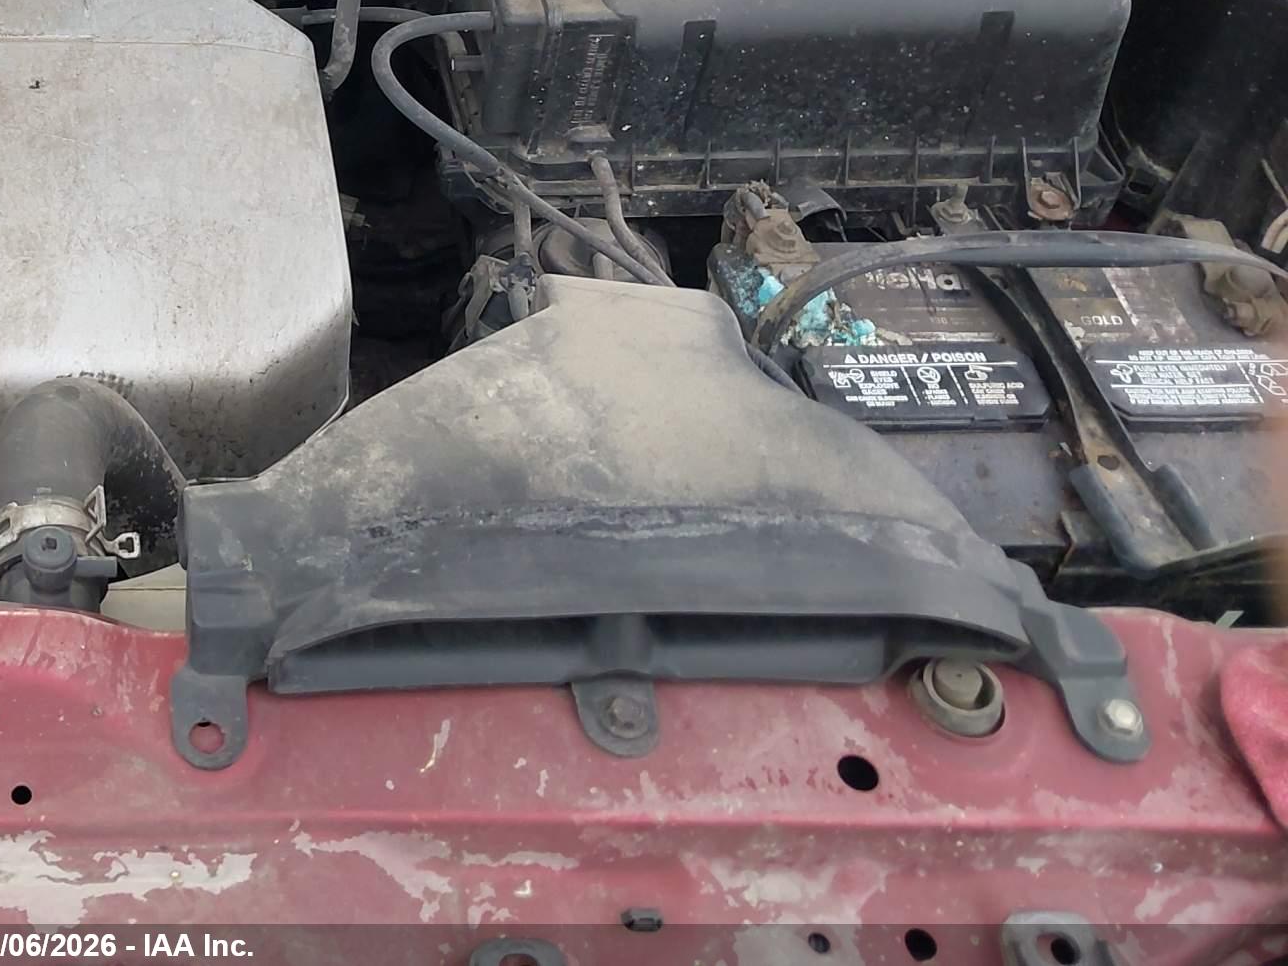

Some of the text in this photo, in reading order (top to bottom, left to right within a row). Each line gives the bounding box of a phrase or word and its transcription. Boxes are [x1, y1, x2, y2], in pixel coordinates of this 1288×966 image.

[1080, 314, 1124, 326] GOLD
[857, 351, 987, 364] DANGER / POISON
